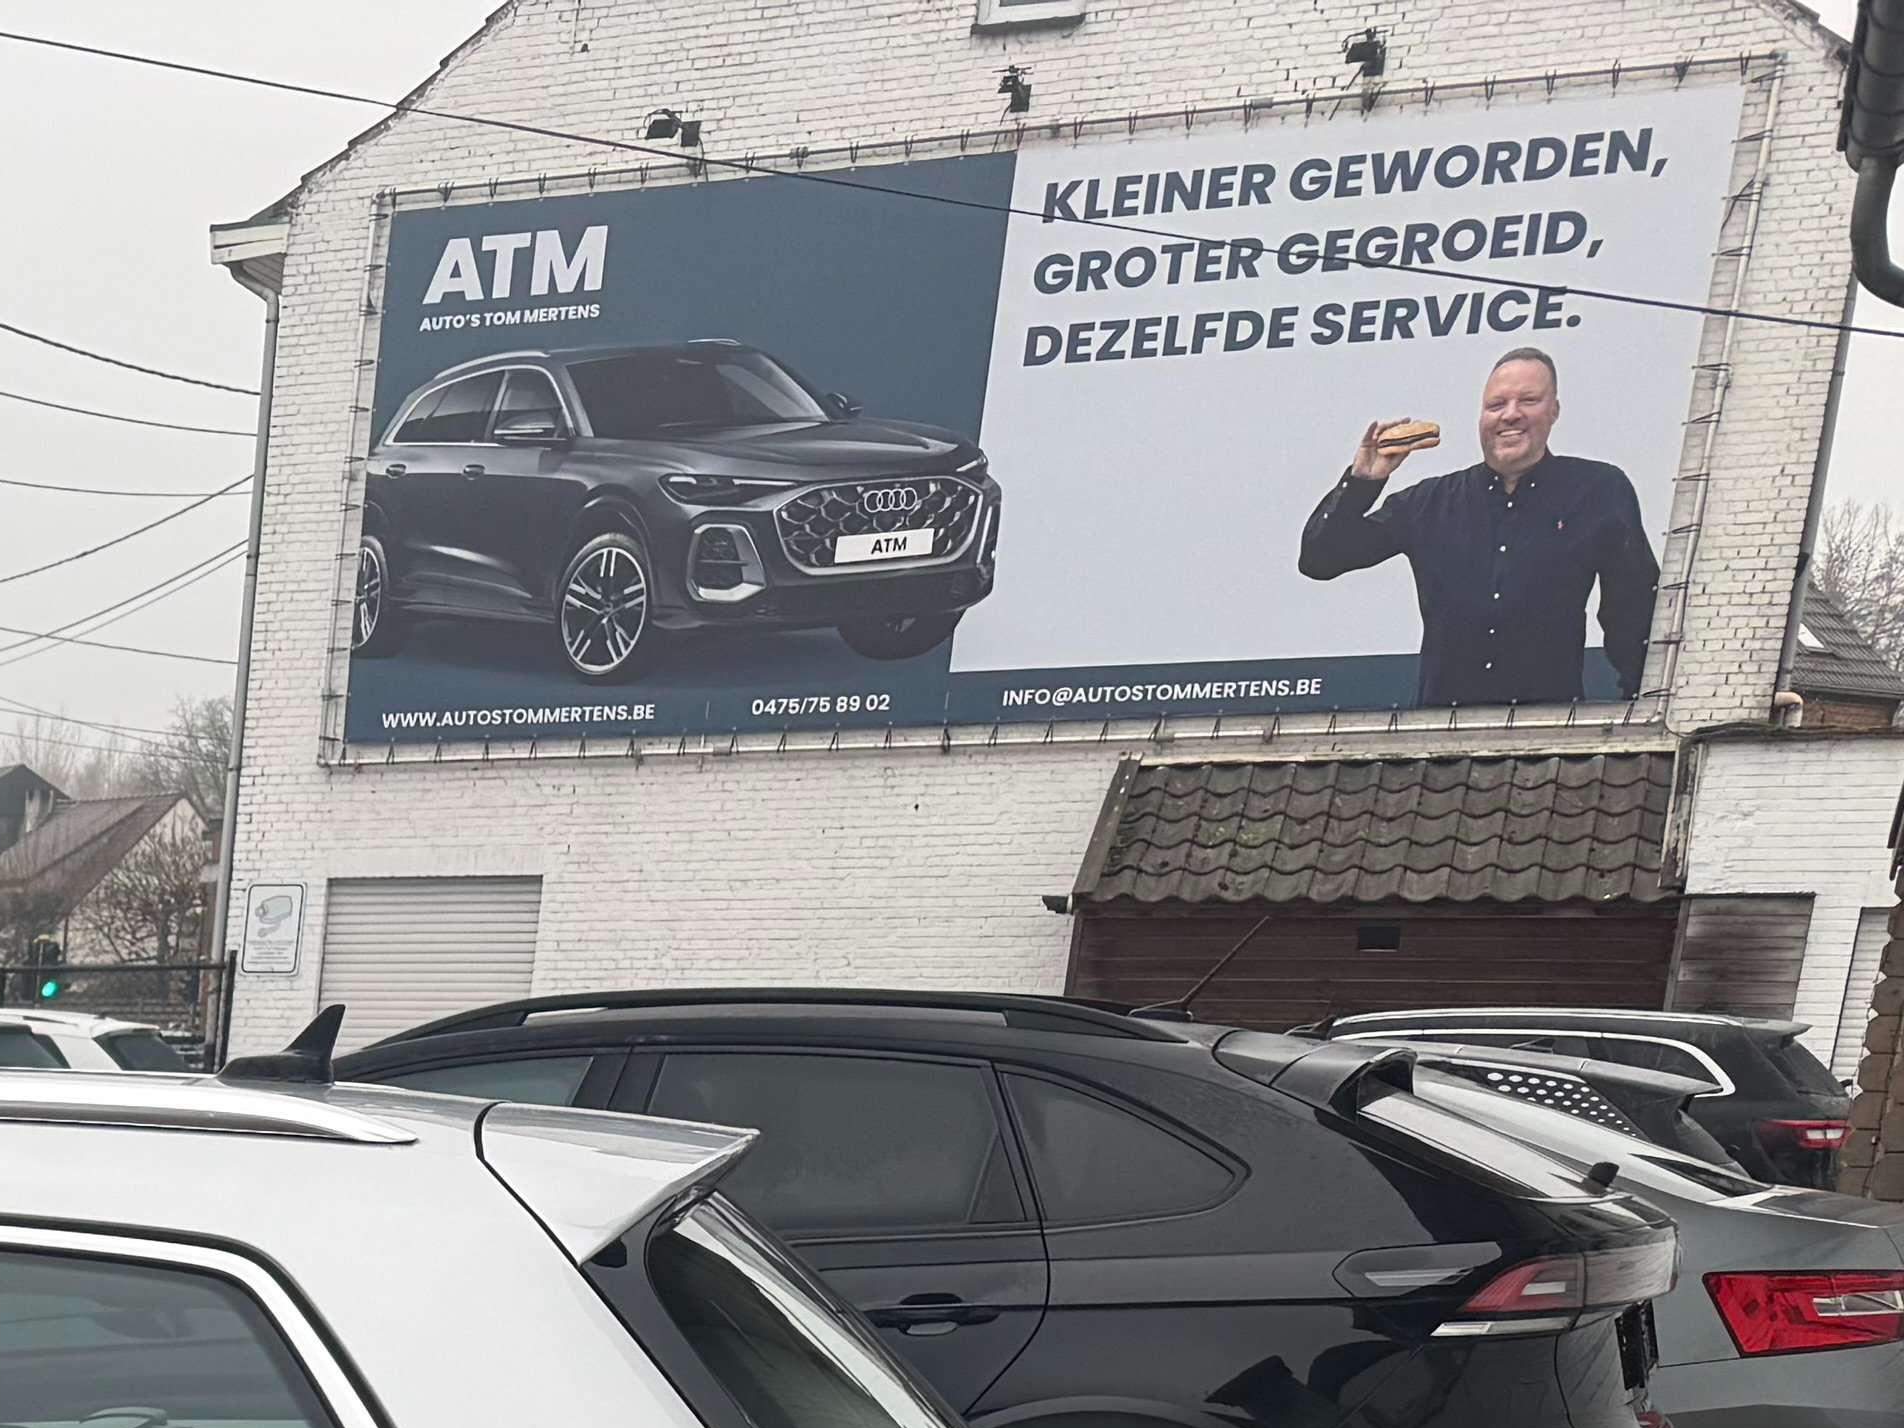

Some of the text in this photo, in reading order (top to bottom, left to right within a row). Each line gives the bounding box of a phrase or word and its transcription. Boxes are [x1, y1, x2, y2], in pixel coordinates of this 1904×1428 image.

[1042, 127, 1669, 224] KLEINER GEWORDEN,
[422, 224, 609, 305] ATM
[1033, 210, 1604, 296] GROTER GEGROEID,
[419, 304, 601, 332] AUTO'S TOM MERTENS
[1022, 285, 1584, 368] DEZELFDE SERVICE.
[871, 537, 908, 555] ATM
[751, 694, 891, 716] 0475/75 89 02
[1001, 677, 1324, 707] INFO@AUTOSTOMMERTENS.BE
[381, 703, 656, 729] WWW.AUTOSTOMMERTENS.BE
